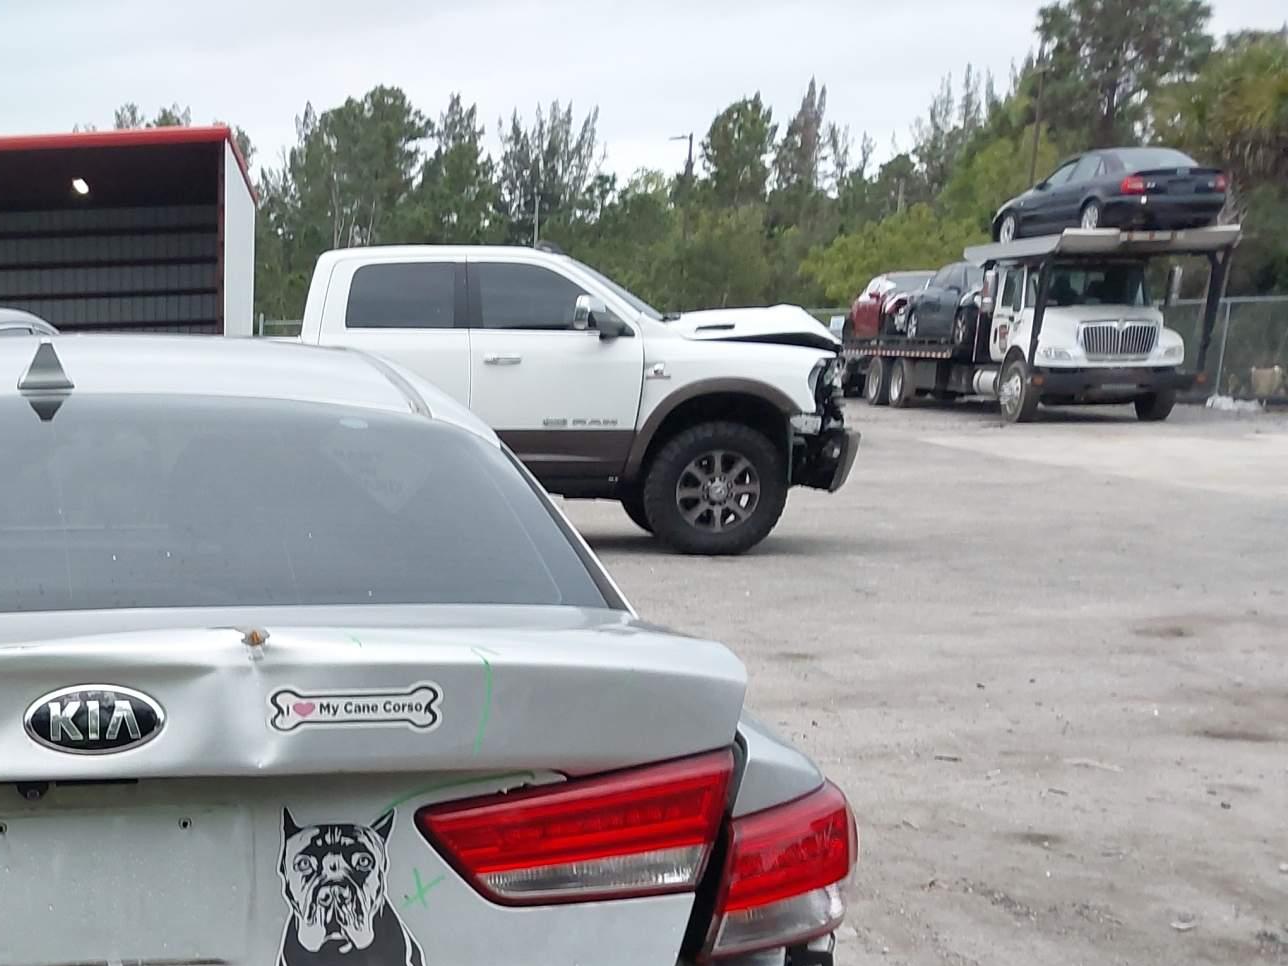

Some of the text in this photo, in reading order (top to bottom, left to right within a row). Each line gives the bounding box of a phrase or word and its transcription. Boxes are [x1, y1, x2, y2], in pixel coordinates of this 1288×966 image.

[48, 700, 142, 741] KIA
[319, 702, 339, 716] My
[344, 701, 379, 714] Cane
[383, 700, 423, 713] Corso
